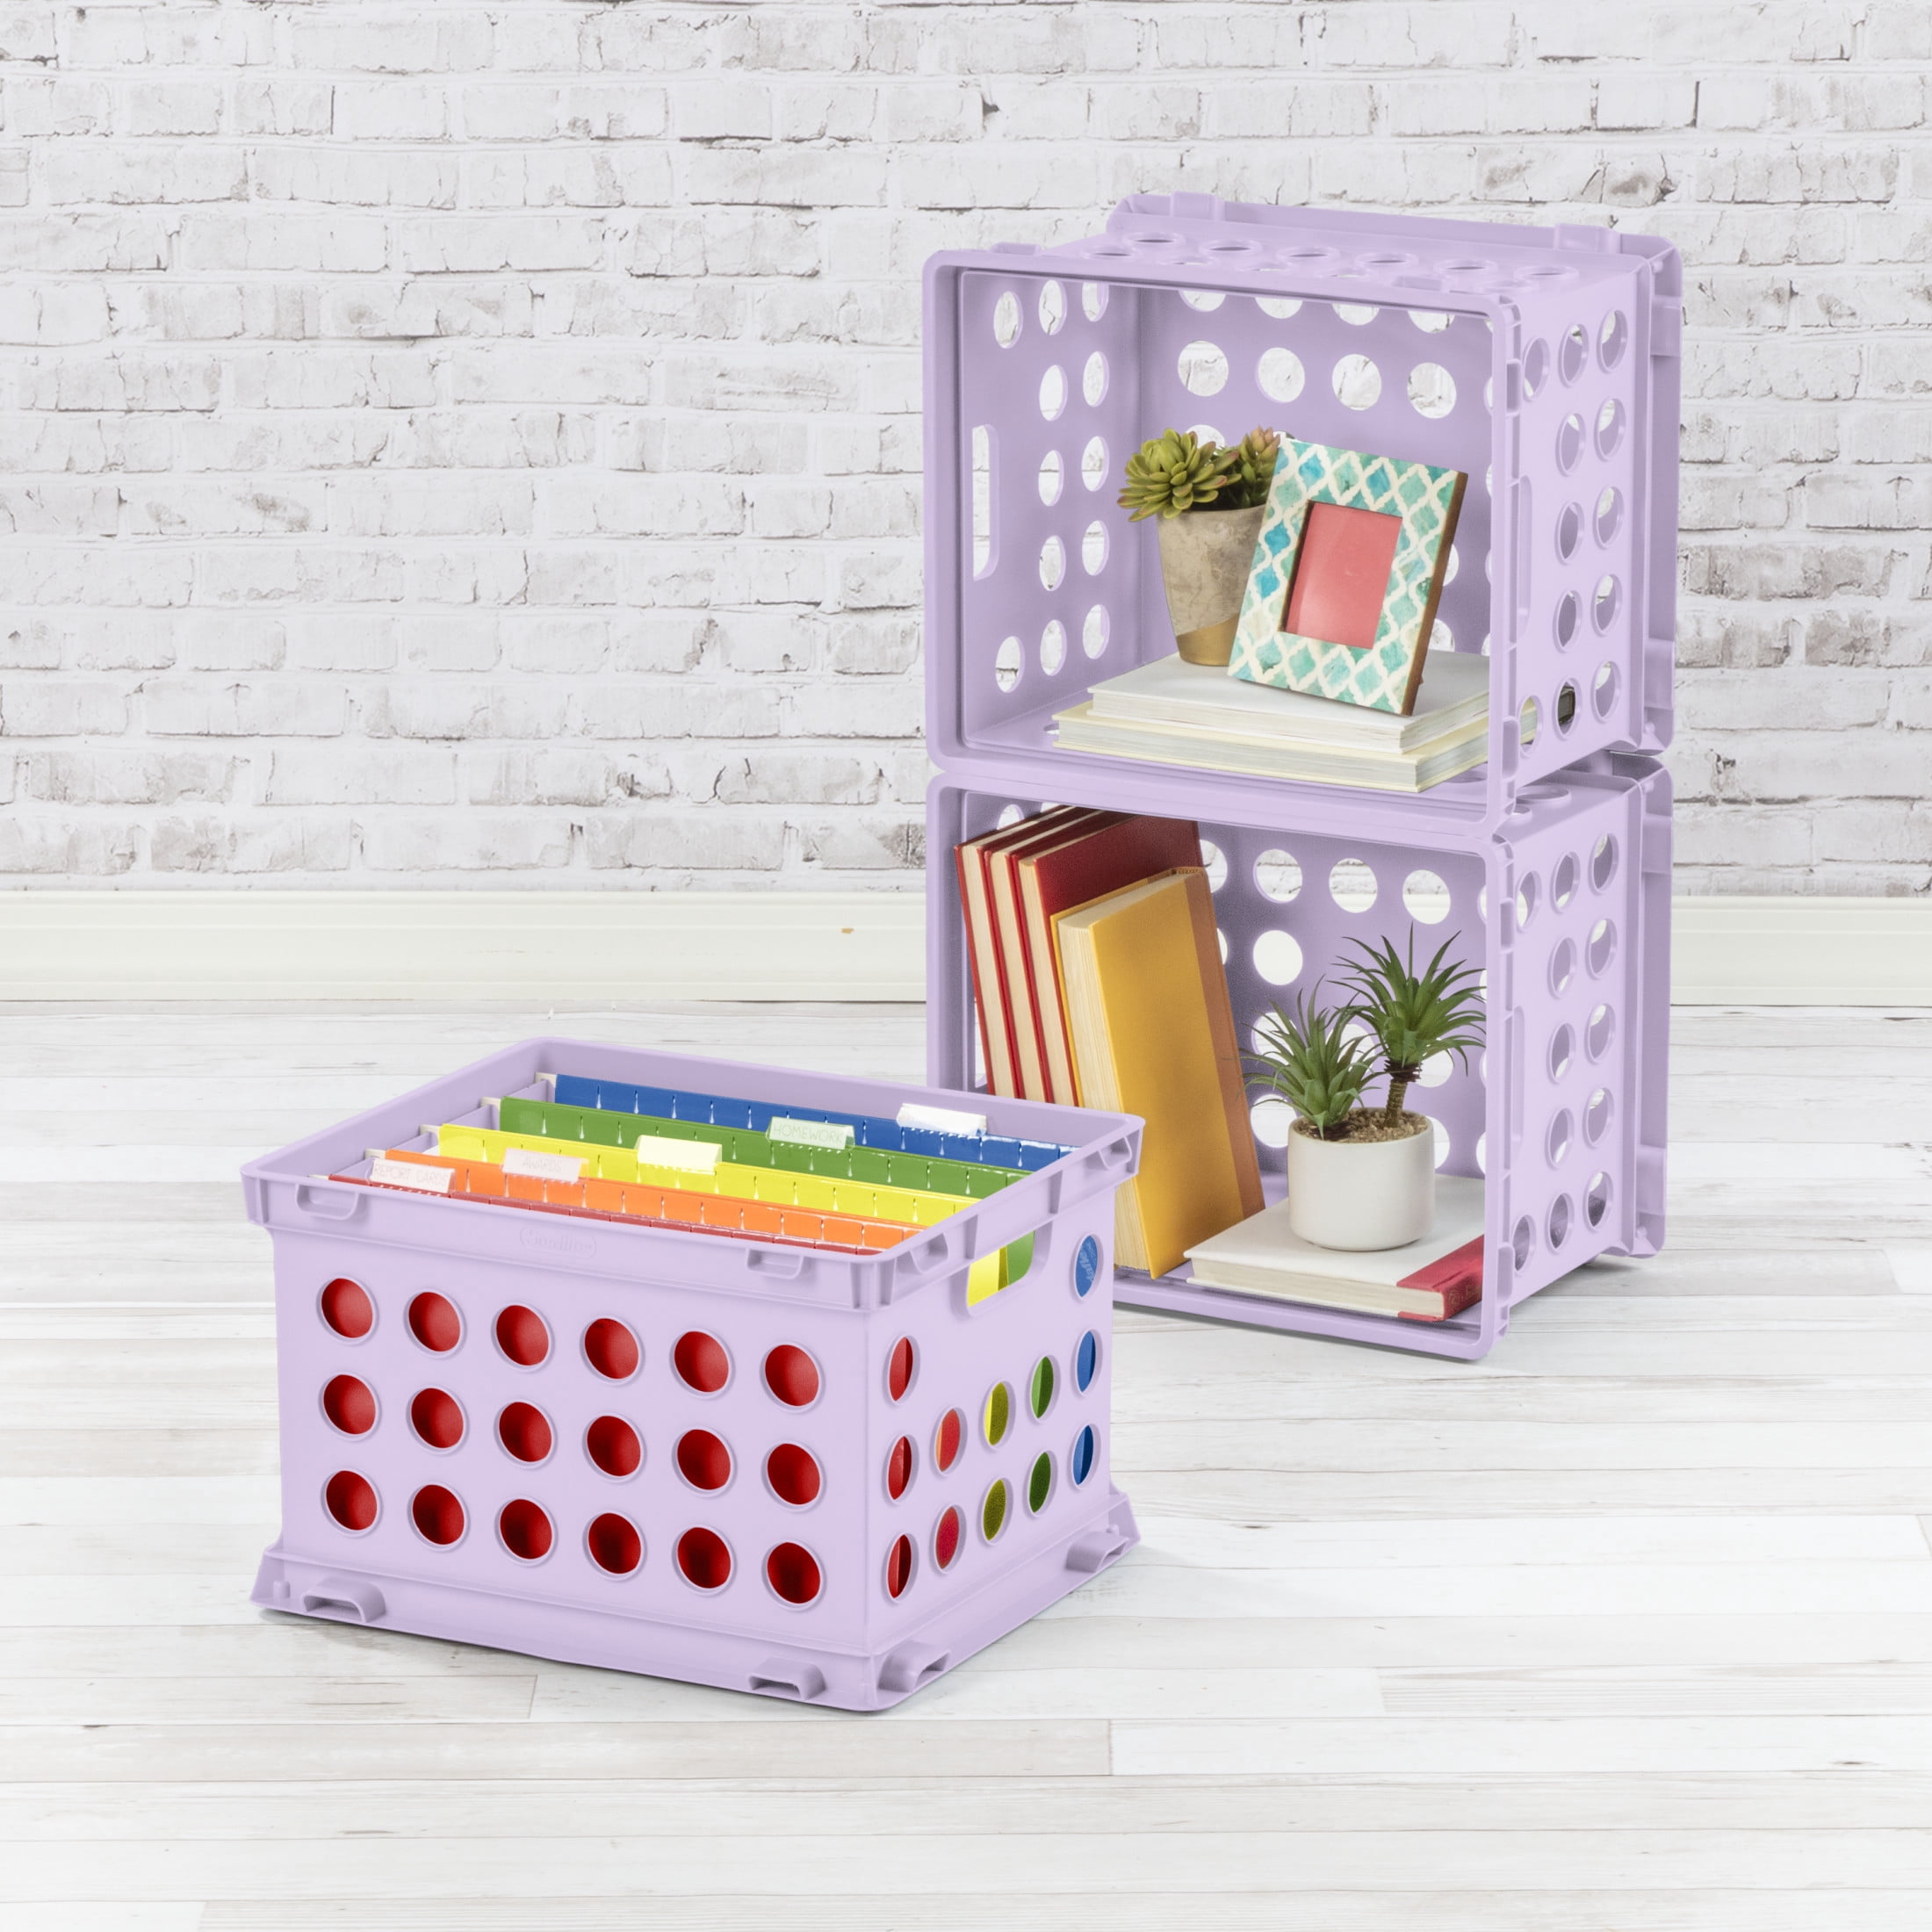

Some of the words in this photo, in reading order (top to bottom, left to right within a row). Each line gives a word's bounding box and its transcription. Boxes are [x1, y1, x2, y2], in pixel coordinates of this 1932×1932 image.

[773, 1123, 844, 1144] HOMEWORK
[373, 1162, 411, 1181] REPORT
[416, 1169, 448, 1187] CARDS
[522, 1155, 563, 1173] AWARDS
